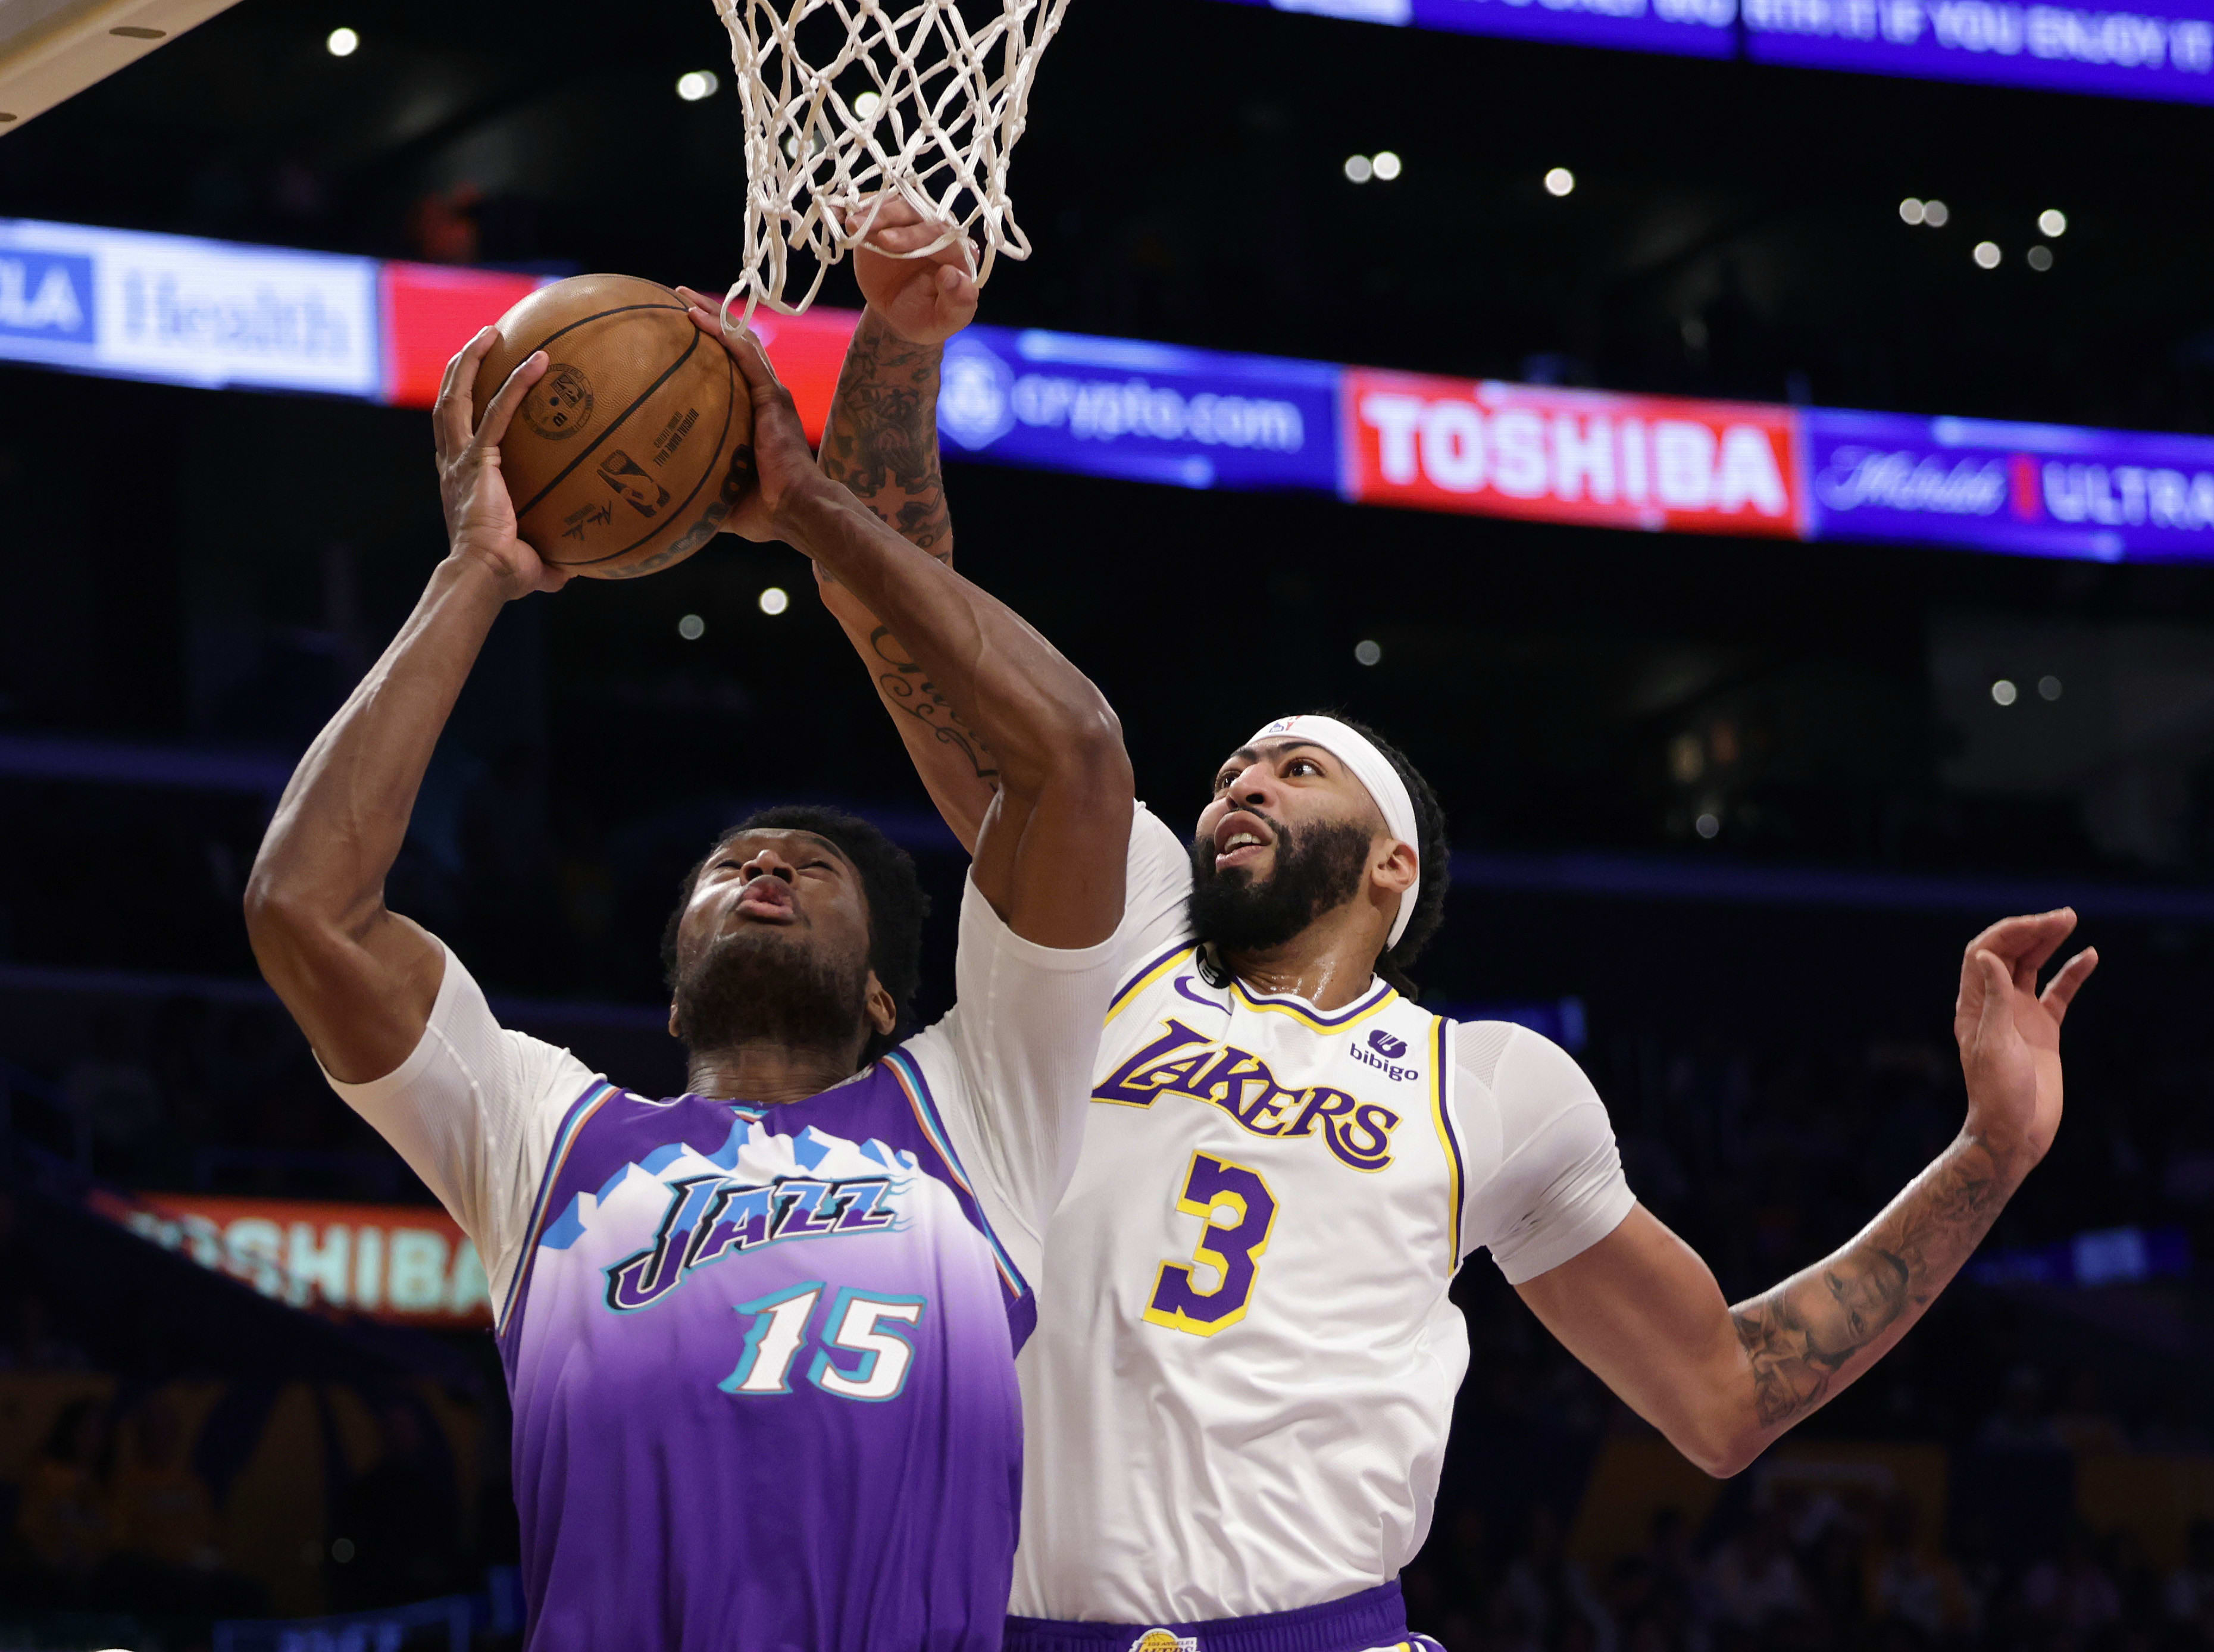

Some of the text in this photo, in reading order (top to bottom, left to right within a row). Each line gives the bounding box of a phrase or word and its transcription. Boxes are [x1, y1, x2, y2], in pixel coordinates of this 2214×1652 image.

[1927, 0, 2025, 55] YOU
[2026, 4, 2167, 70] ENJOY
[1013, 374, 1305, 454] crypto.com
[1360, 392, 1787, 517] TOSHIBA
[1090, 1018, 1403, 1174] LAKERS
[1350, 1041, 1419, 1082] bibigo
[129, 1210, 491, 1316] SHIBA
[601, 1173, 902, 1315] JAZZ
[1141, 1149, 1280, 1338] 3
[717, 1280, 928, 1403] 15
